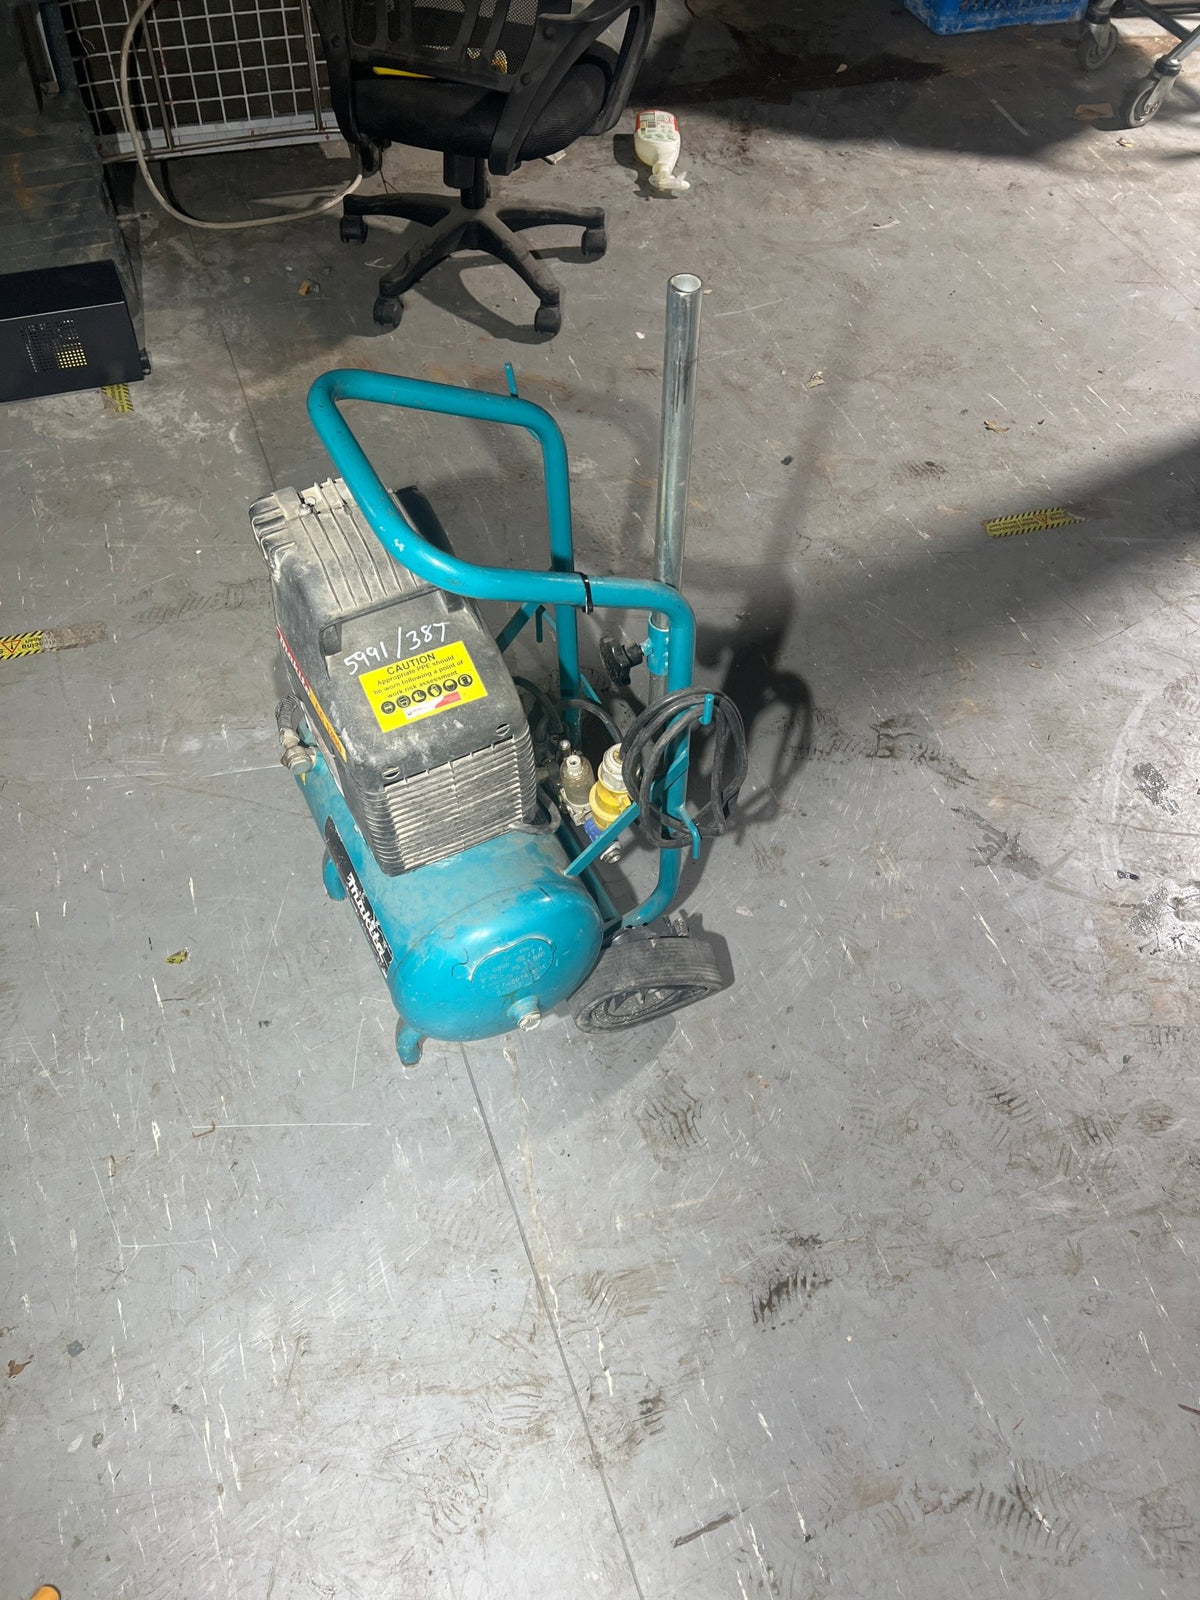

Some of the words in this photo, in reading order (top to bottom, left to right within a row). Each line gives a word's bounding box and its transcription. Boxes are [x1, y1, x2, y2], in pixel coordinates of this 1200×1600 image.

[377, 669, 415, 686] Appropriate
[416, 664, 431, 672] PPE
[432, 655, 455, 666] should
[384, 682, 401, 691] worn
[401, 671, 432, 684] following
[438, 663, 456, 674] point
[386, 652, 436, 675] CAUTION
[387, 690, 403, 699] work
[404, 684, 418, 692] risk
[418, 671, 458, 687] assessment
